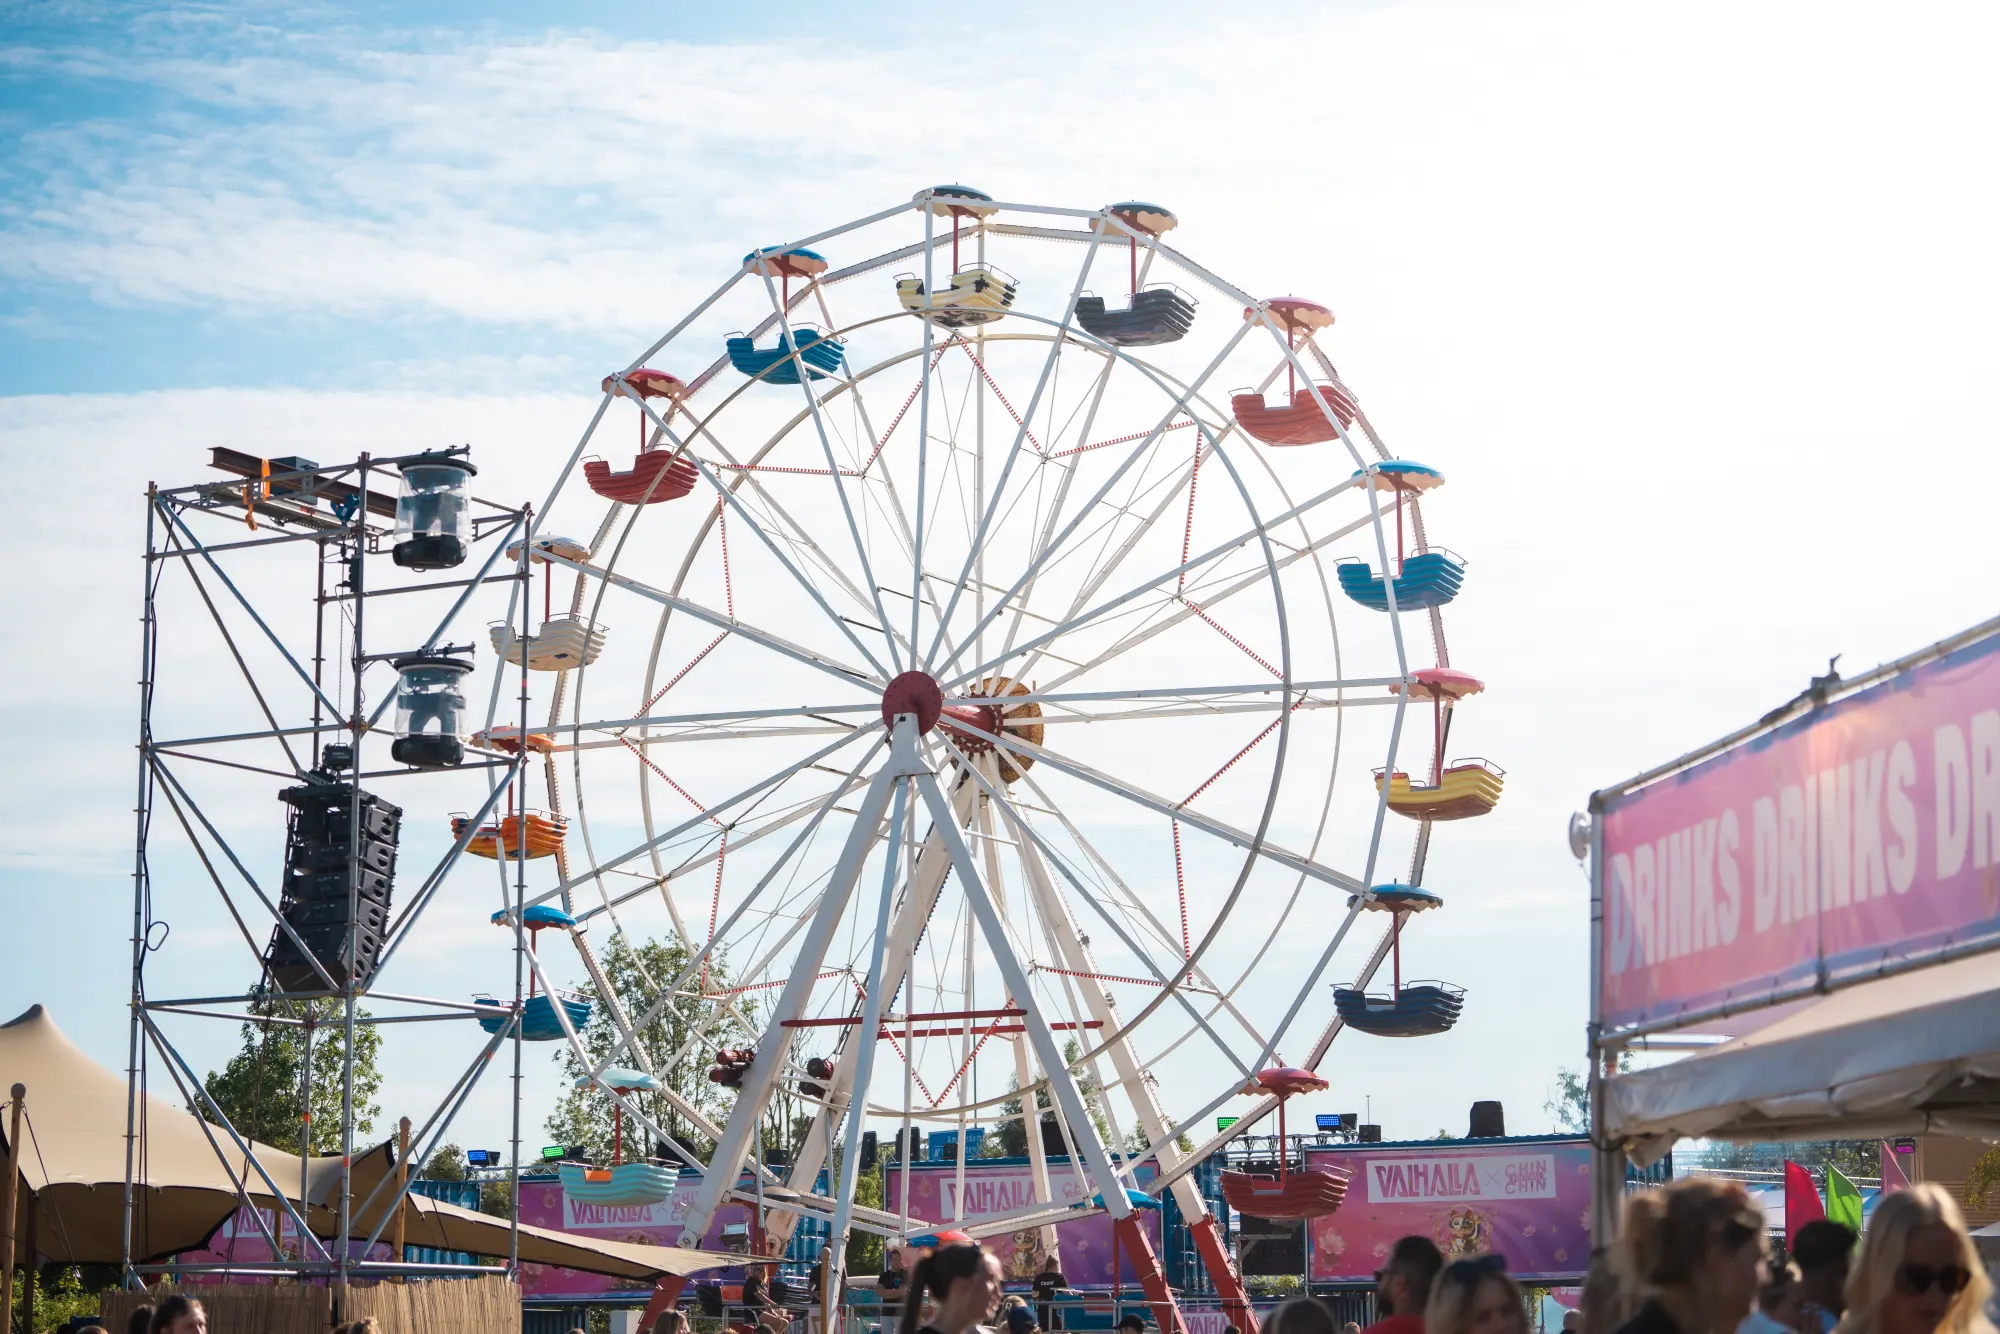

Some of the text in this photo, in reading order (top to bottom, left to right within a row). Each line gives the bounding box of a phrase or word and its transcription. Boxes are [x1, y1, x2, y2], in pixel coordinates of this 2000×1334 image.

[1609, 808, 1742, 975] DRINKS
[1753, 740, 1918, 934] DRINKS
[1374, 1162, 1481, 1198] VALHALLA
[1505, 1159, 1547, 1177] CHIN
[1505, 1177, 1547, 1194] CHIN
